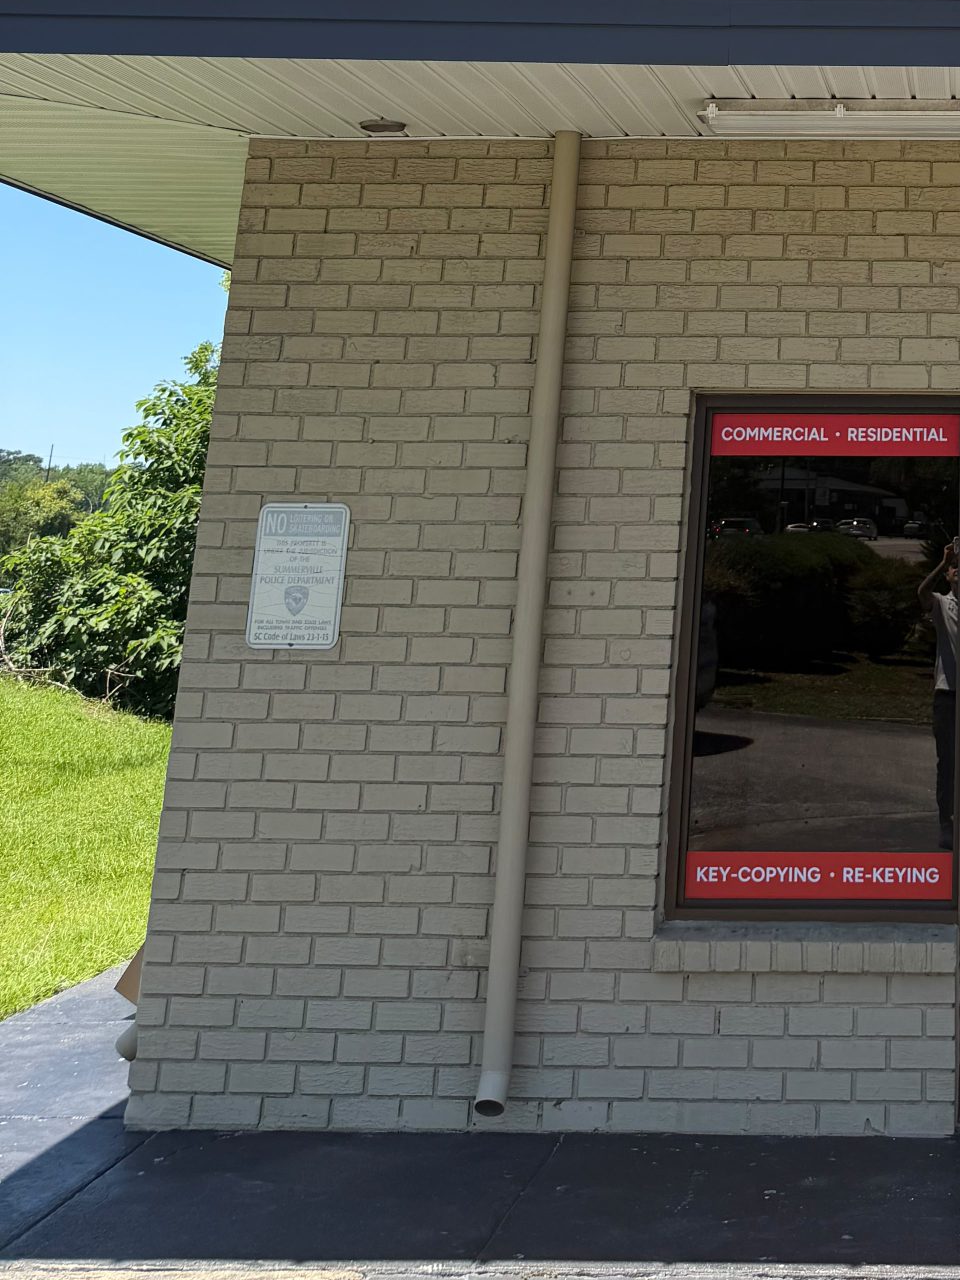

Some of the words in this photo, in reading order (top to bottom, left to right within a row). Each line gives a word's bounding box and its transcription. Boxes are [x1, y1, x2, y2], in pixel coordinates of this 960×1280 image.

[721, 427, 829, 441] COMMERCIAL
[847, 427, 949, 442] RESIDENTIAL
[266, 512, 287, 534] NO
[290, 524, 341, 533] SKATEBOARDING
[275, 565, 324, 574] SUMMERVILLE
[261, 576, 284, 585] POLICE
[288, 576, 336, 585] DEPARTMENT
[254, 632, 262, 641] SC
[264, 631, 281, 641] Code
[282, 631, 288, 641] of
[290, 632, 305, 641] Laws
[696, 866, 821, 883] KEY-COPYING
[842, 867, 940, 883] RE-KEYING
